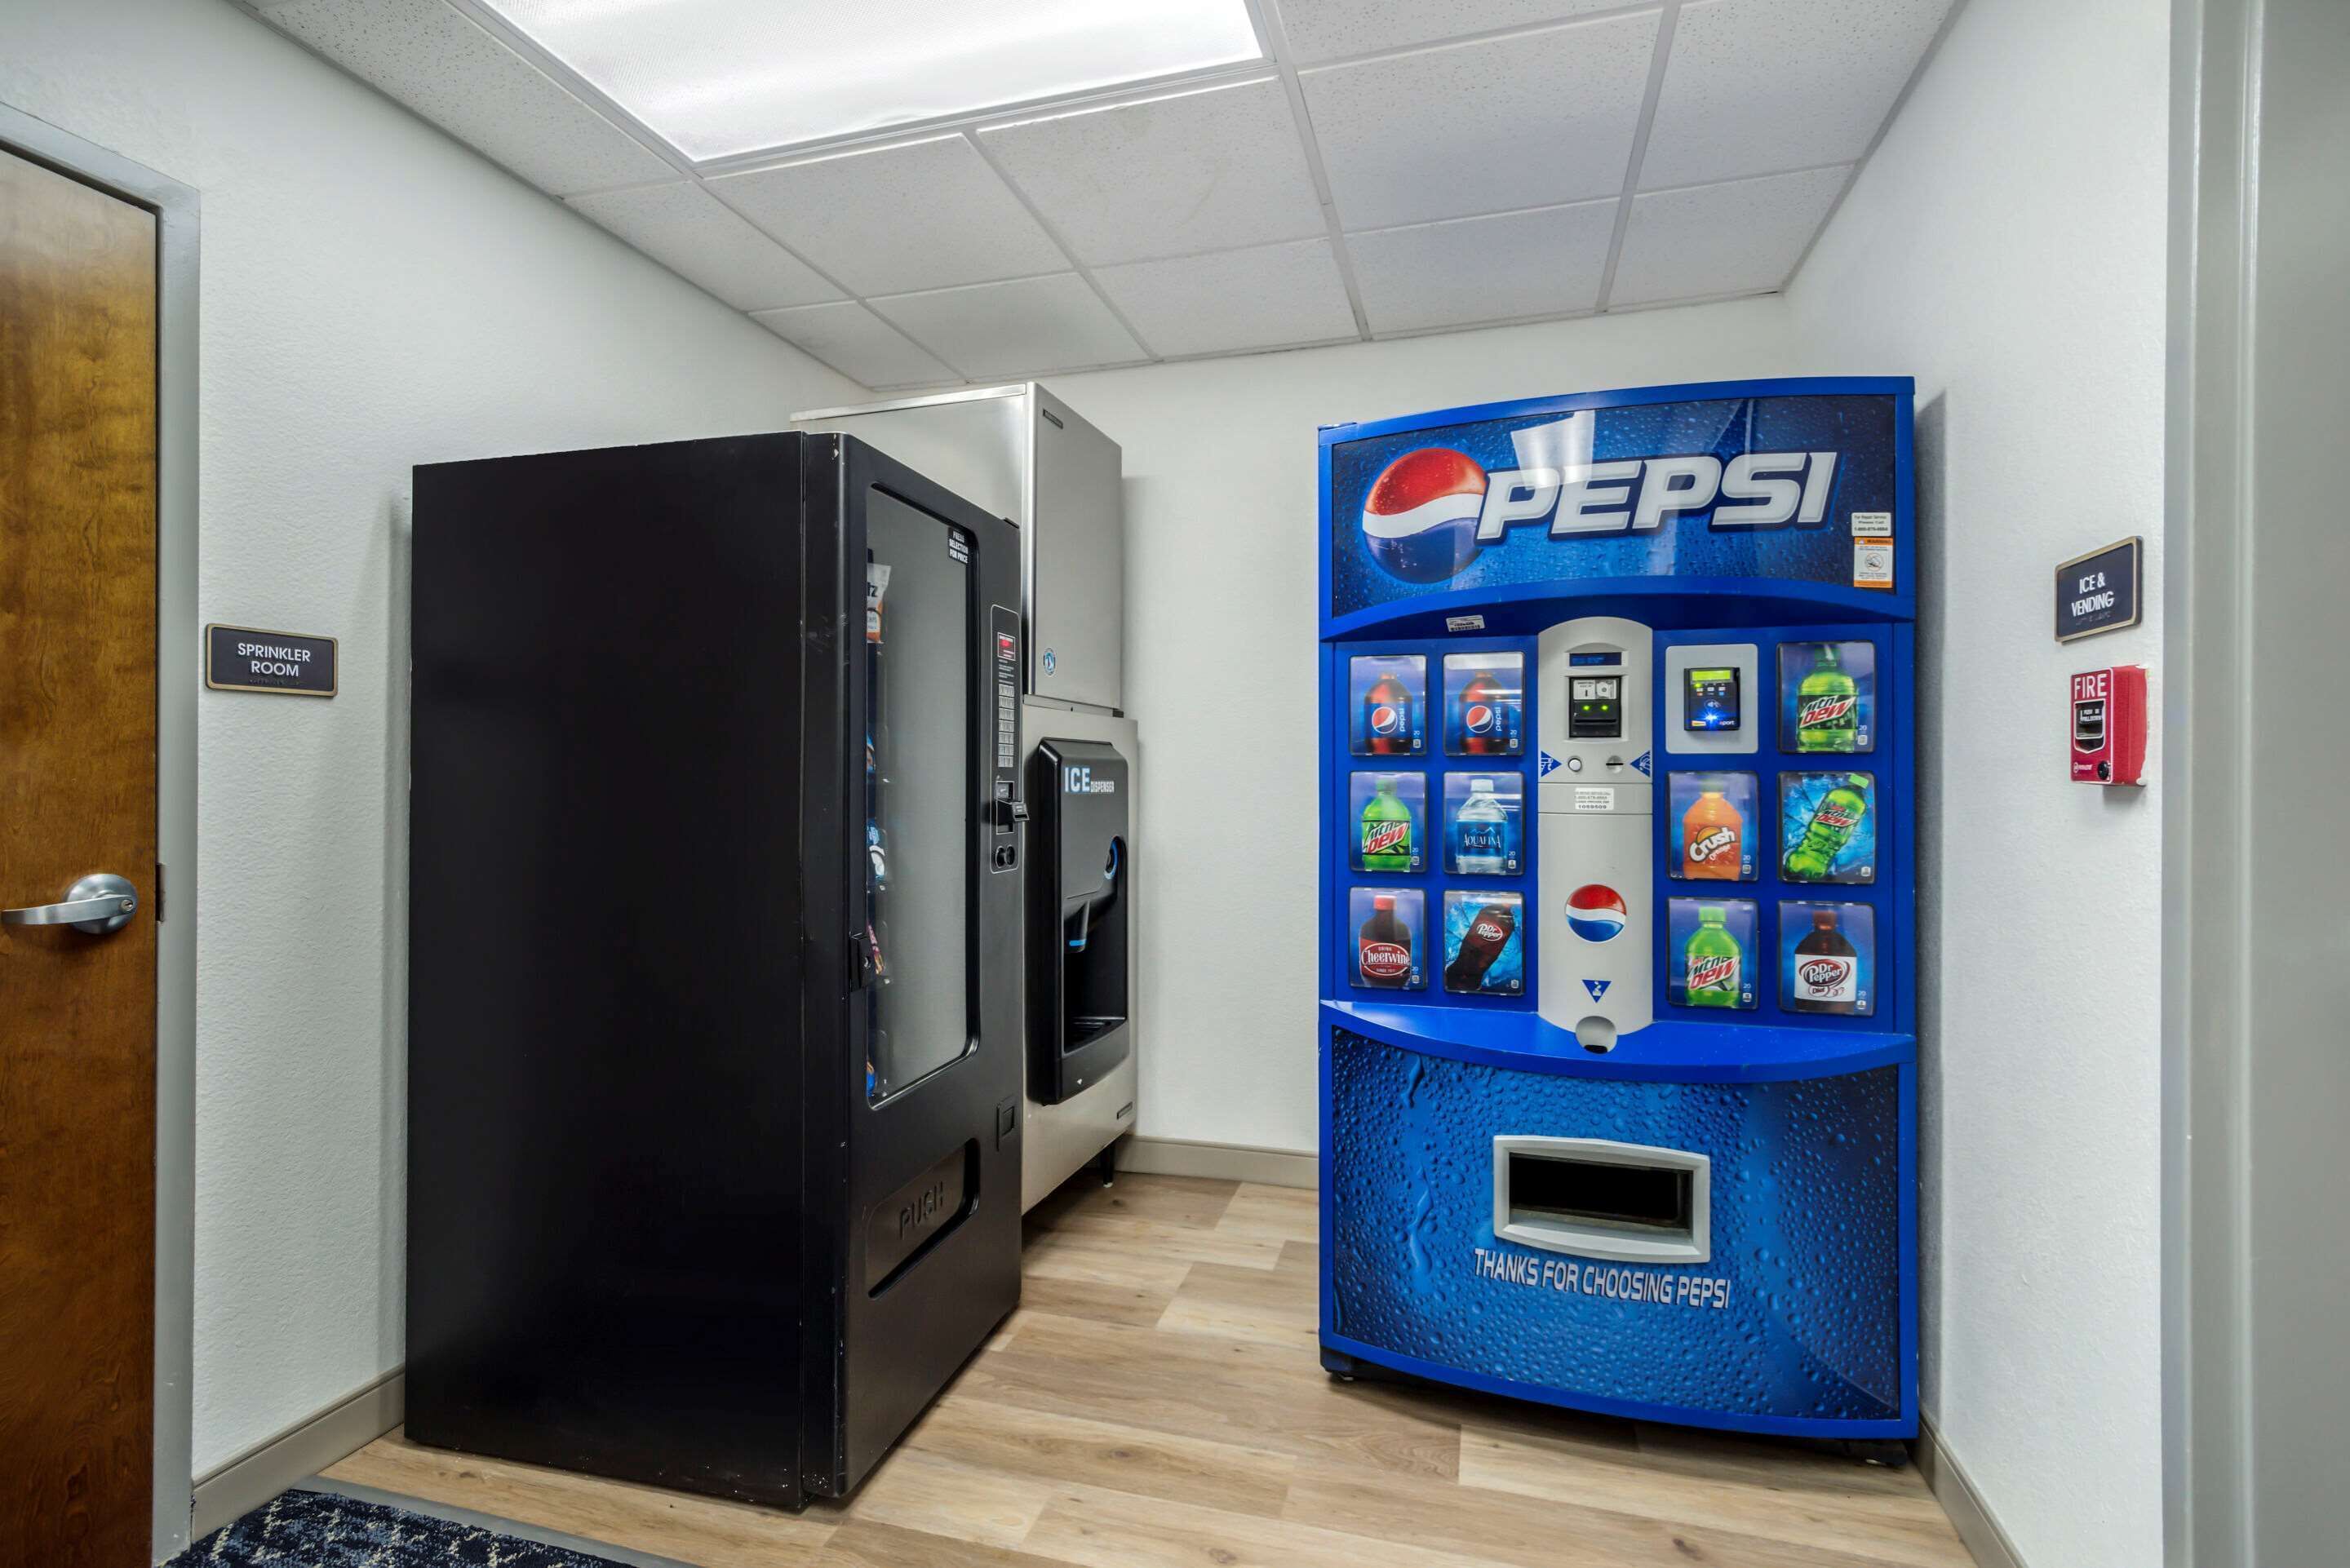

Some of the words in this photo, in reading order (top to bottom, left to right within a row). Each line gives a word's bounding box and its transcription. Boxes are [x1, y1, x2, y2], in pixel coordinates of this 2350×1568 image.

[1476, 451, 1837, 540] PEPSI
[2079, 574, 2095, 594] ICE
[2097, 572, 2105, 587] &
[2071, 591, 2115, 617] VENDING
[237, 642, 311, 662] SPRINKLER
[251, 660, 299, 677] ROOM
[2074, 673, 2107, 700] FIRE
[1064, 767, 1091, 792] ICE
[1090, 780, 1115, 793] DISPENSER
[1464, 833, 1501, 848] AQUAFINA
[1689, 826, 1736, 862] Crush
[1362, 949, 1410, 966] Cheerwine
[1818, 963, 1833, 972] Dr
[1809, 966, 1842, 983] Pepper
[899, 1180, 943, 1239] PUSH
[1474, 1247, 1539, 1287] THANKS
[1542, 1260, 1579, 1292] FOR
[1582, 1266, 1674, 1305] CHOOSING
[1676, 1275, 1731, 1309] PEPSI
